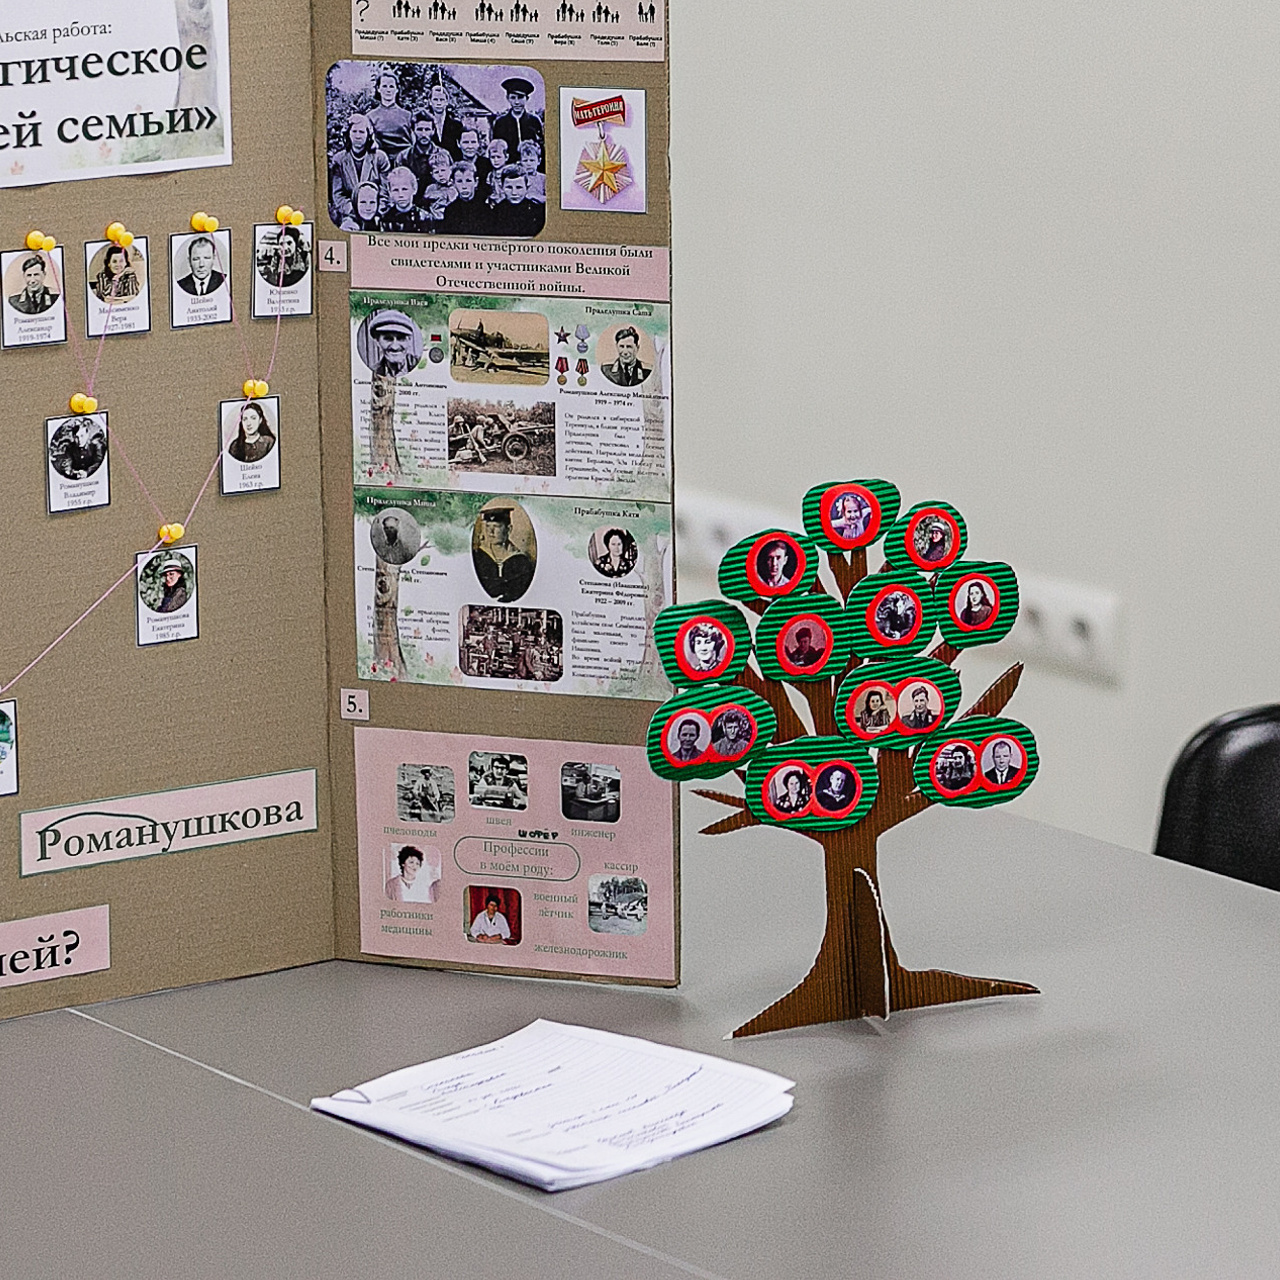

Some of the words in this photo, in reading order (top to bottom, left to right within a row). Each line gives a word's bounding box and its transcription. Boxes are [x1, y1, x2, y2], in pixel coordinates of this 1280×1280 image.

[53, 21, 112, 44] работа:
[0, 43, 207, 86] гическое
[57, 106, 218, 144] семьи»
[324, 246, 341, 265] 4.
[368, 235, 390, 248] Все
[394, 238, 419, 249] мои
[423, 239, 469, 252] предки
[473, 240, 544, 255] четвёртого
[548, 244, 617, 257] поколения
[620, 245, 653, 259] были
[390, 257, 471, 271] свидетелями
[475, 260, 483, 270] и
[487, 261, 571, 275] участниками
[575, 262, 630, 276] Великой
[436, 275, 536, 291] Отечественной
[539, 279, 586, 293] войны.
[346, 694, 363, 714] 5.
[486, 816, 513, 826] швея
[36, 799, 304, 862] Романушкова
[383, 826, 437, 838] пчеловоды
[571, 828, 616, 841] инженер
[483, 841, 549, 858] Профессии
[480, 862, 487, 870] в
[490, 859, 520, 872] моём
[523, 863, 553, 877] роду:
[604, 863, 639, 874] кассир
[533, 892, 578, 905] военный
[380, 908, 434, 922] работники
[538, 907, 574, 919] лётчик
[381, 924, 433, 937] медицины
[534, 942, 628, 960] железнодорожник
